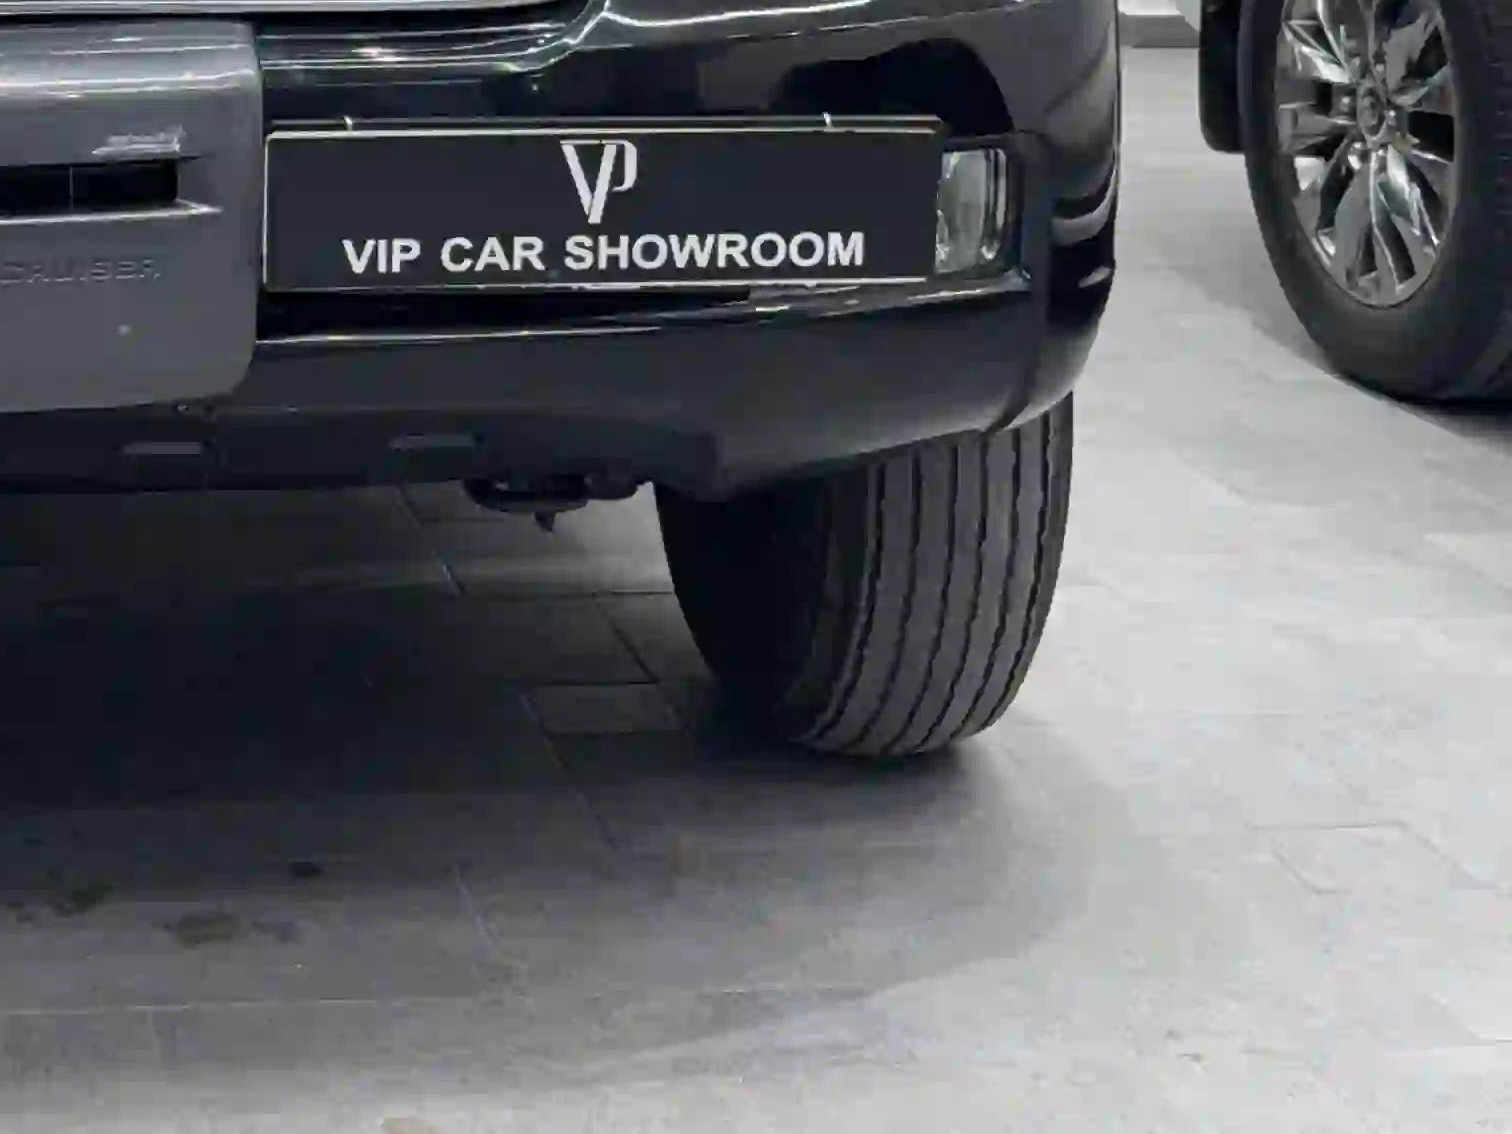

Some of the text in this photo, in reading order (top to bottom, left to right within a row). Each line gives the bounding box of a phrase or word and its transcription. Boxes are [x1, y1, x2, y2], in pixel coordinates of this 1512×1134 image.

[341, 231, 865, 275] VIP CAR SHOWROOM
